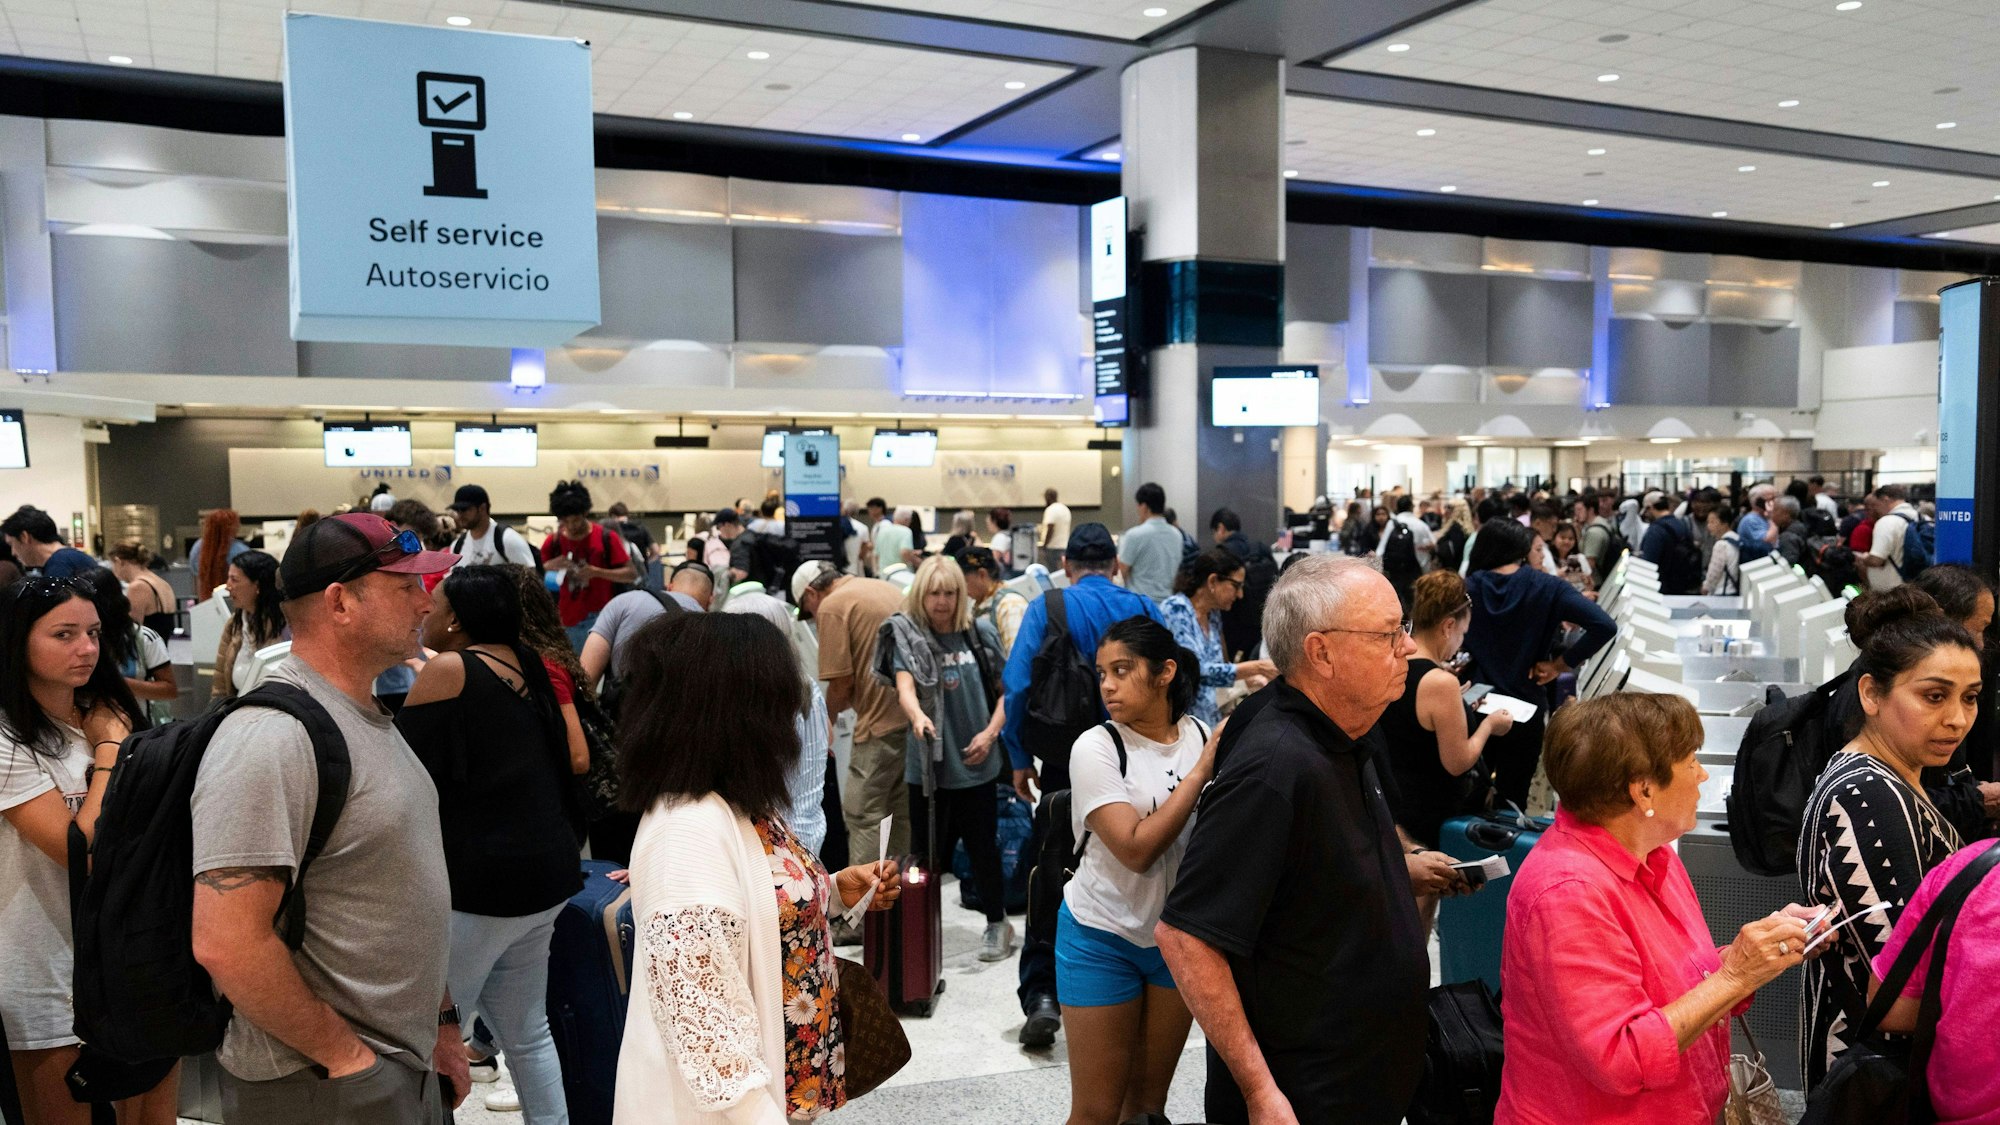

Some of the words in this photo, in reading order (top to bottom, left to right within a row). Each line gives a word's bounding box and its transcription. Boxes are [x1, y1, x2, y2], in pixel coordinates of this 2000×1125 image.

[369, 217, 429, 244] Self
[437, 223, 544, 248] service
[366, 262, 550, 291] Autoservicio
[360, 469, 431, 479] UNITED
[577, 468, 641, 478] UNITED
[1938, 510, 1972, 522] UNITED
